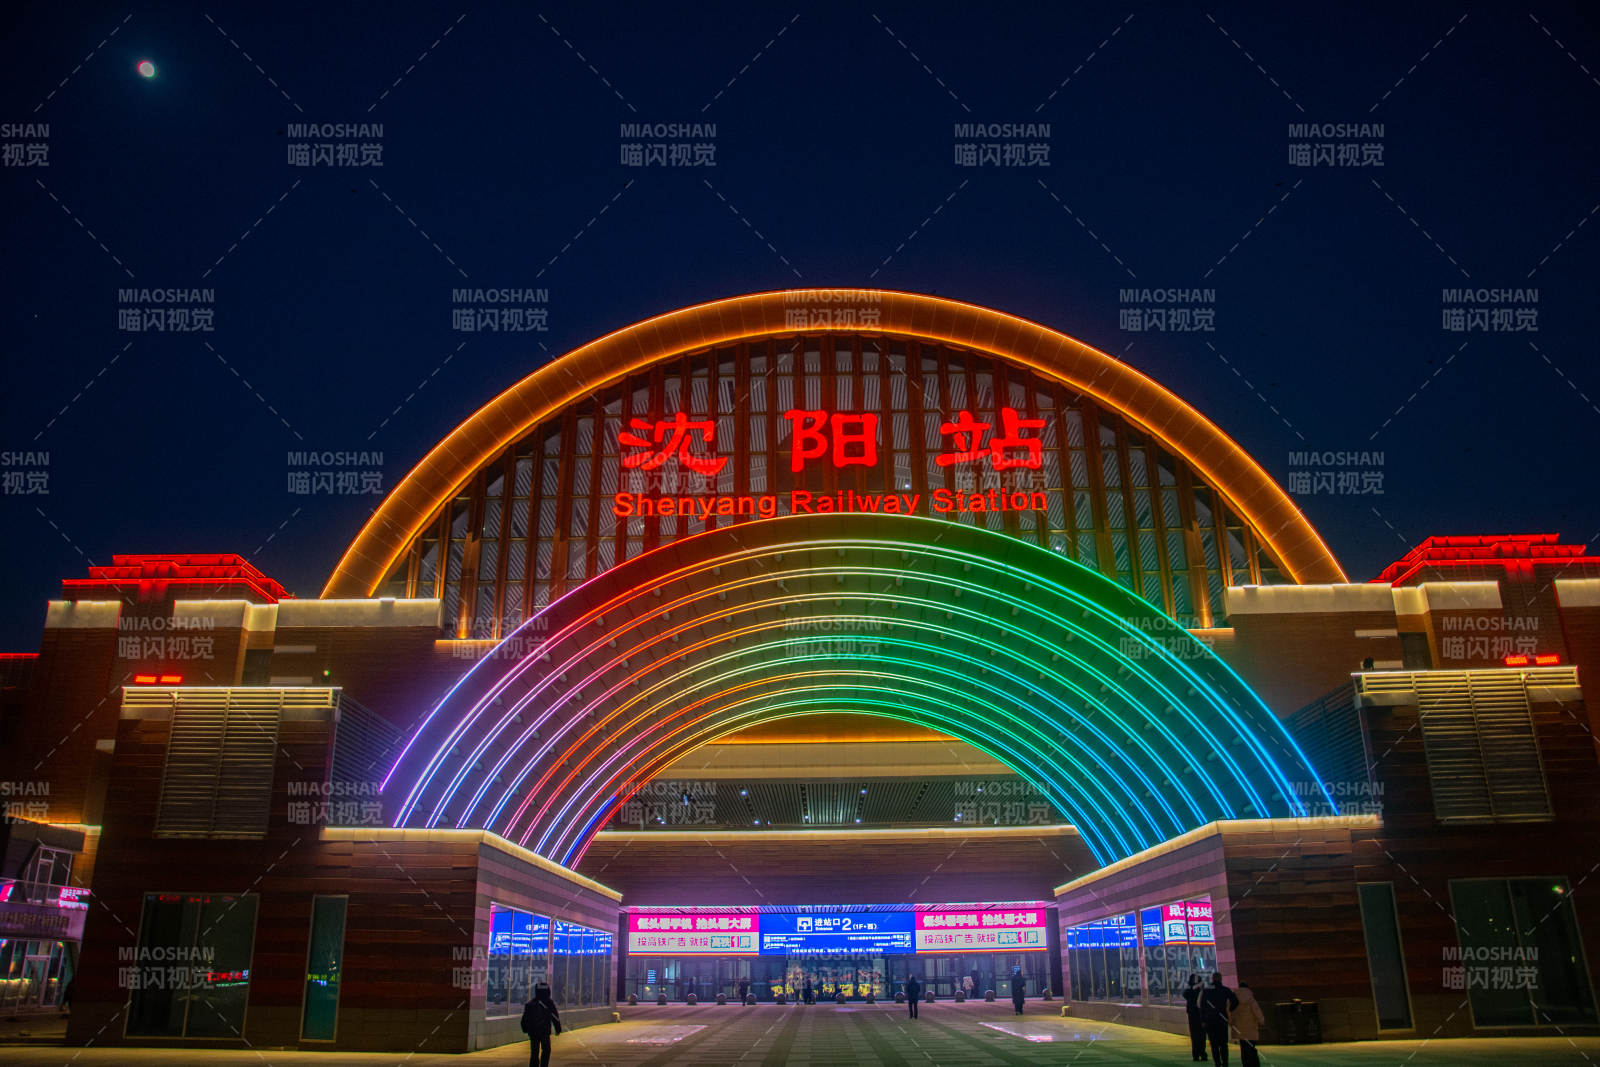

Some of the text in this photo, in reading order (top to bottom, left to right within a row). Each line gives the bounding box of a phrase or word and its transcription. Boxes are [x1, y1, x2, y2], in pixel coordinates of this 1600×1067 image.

[618, 408, 1046, 475] 沈阳站
[613, 488, 1048, 520] Shenyang Railway Station
[815, 918, 840, 926] 进站口
[842, 918, 851, 930] 2
